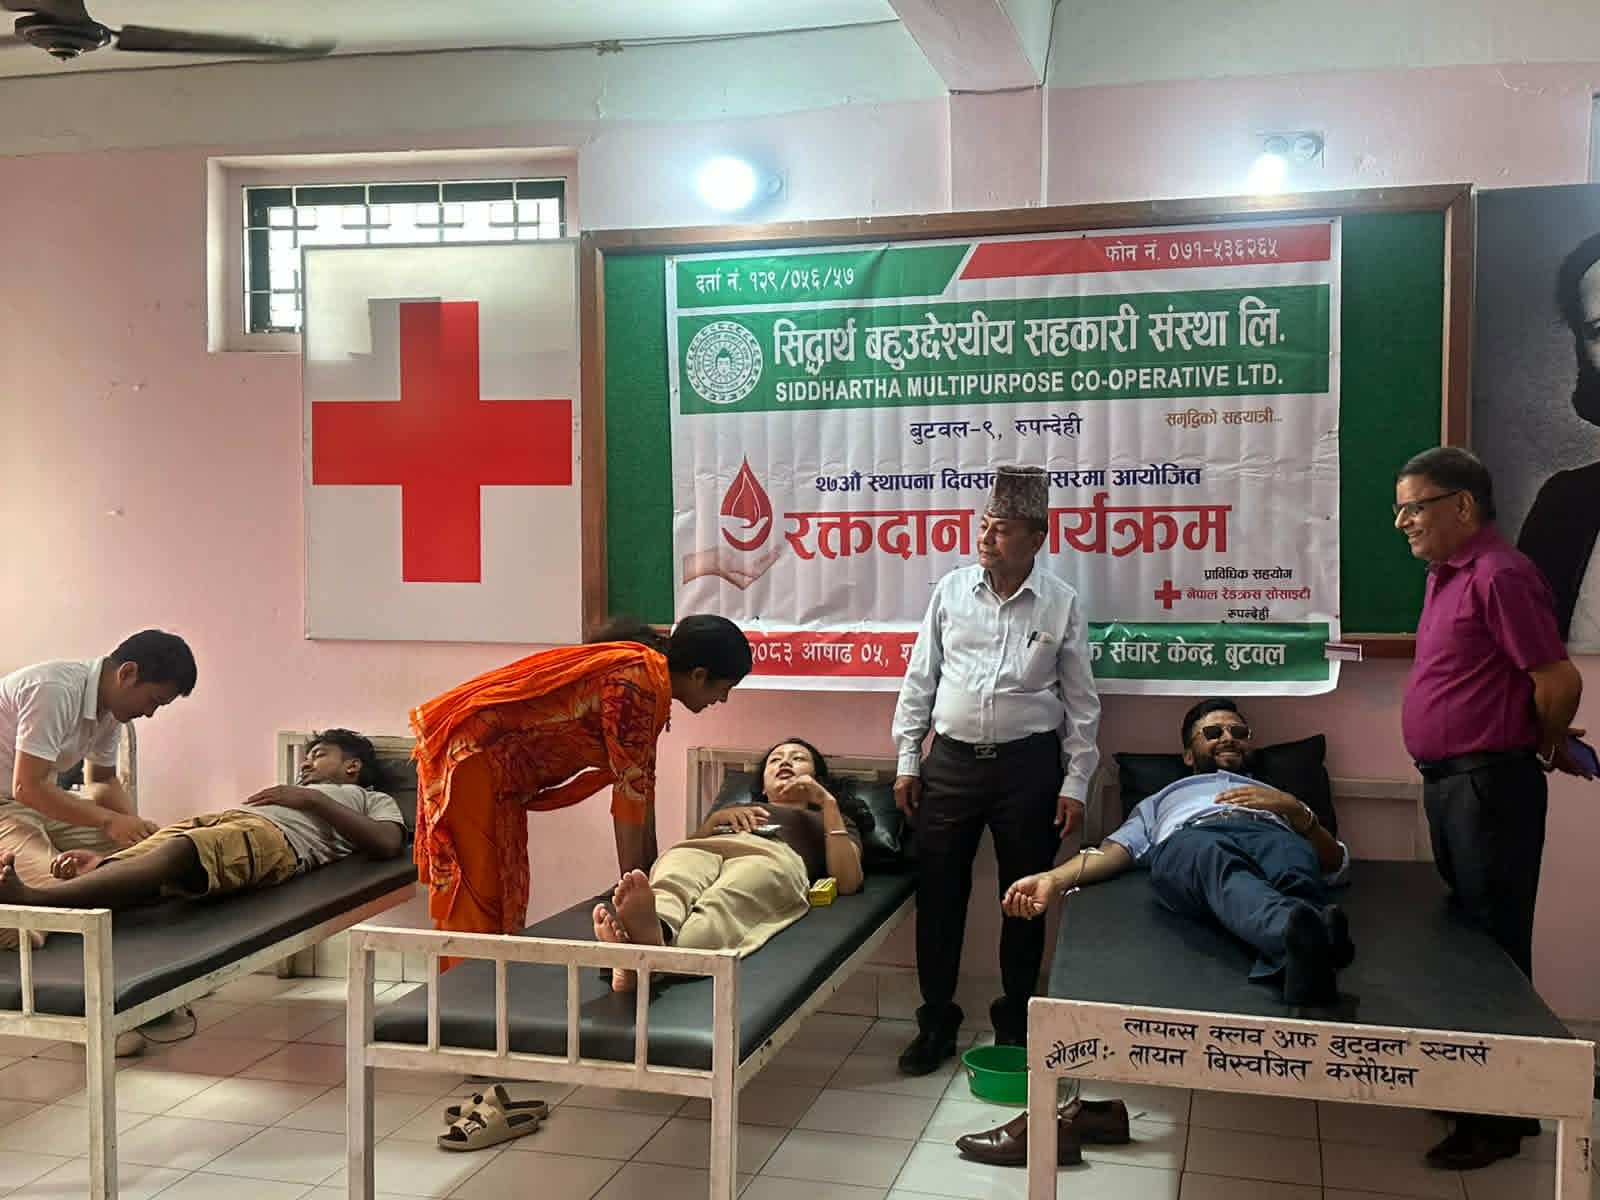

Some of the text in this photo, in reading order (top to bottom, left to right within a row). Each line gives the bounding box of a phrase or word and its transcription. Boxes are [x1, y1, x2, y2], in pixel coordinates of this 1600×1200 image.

[1105, 241, 1138, 261] फोन
[1144, 241, 1160, 261] नं.
[695, 267, 855, 293] दर्ता नं. १२९/०५६/५७
[773, 318, 857, 375] सिद्धार्थ
[865, 310, 1015, 370] बहुउद्देश्यीय
[1023, 303, 1139, 357] सहकारी
[1148, 304, 1229, 353] संस्था
[1239, 295, 1286, 346] लि.
[775, 363, 1283, 402] SIDDHARTHA MULTIPURPOSE CO-OPERATIVE LTD.
[1015, 412, 1083, 439] रुपन्देही
[868, 473, 935, 492] स्थापना
[1112, 464, 1202, 486] आयोजित
[784, 509, 975, 560] रक्तदान
[1204, 566, 1293, 580] प्राविधिक सहयोग
[1186, 587, 1218, 600] नेपाल
[1265, 586, 1311, 600] सोसाइटी
[1227, 606, 1270, 621] रुपन्देही
[802, 642, 855, 664] आषाढ
[861, 643, 889, 667] ०५,
[1109, 637, 1161, 663] संचार
[1225, 643, 1286, 670] बुटवल
[1124, 1018, 1198, 1041] लायन्स
[1272, 1029, 1318, 1049] अफ
[1128, 1044, 1188, 1070] लायन
